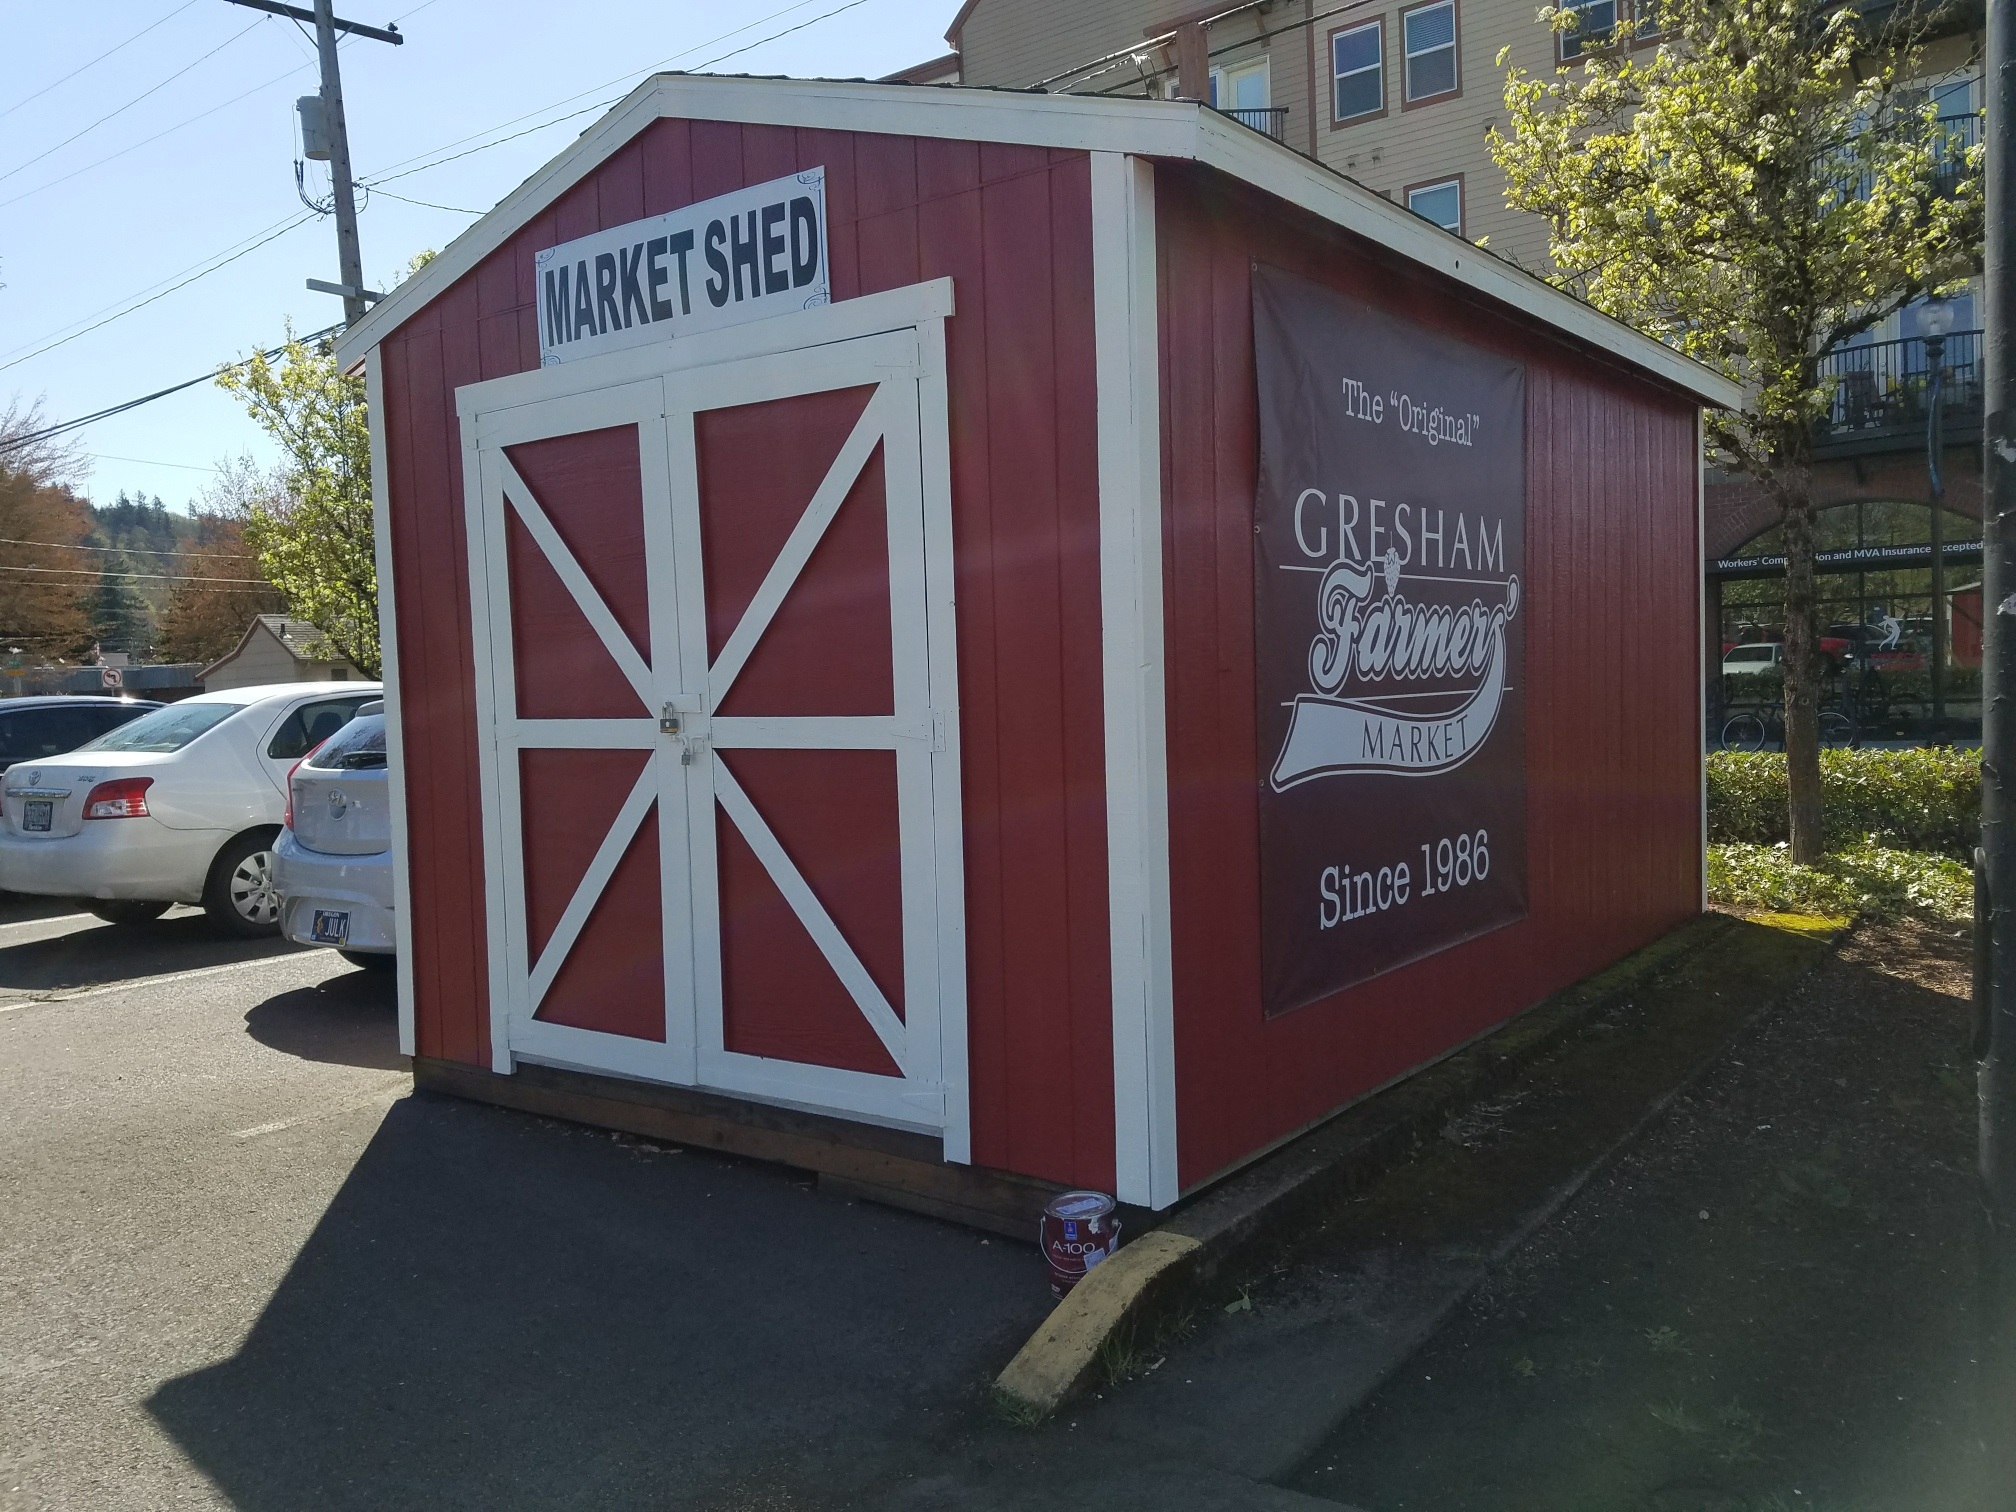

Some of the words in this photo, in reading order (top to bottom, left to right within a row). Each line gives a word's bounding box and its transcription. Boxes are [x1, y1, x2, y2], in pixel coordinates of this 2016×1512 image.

[545, 228, 694, 347] MARKET
[704, 195, 818, 308] SHED
[1342, 377, 1384, 424] The
[1294, 488, 1504, 573] GRESHAM
[1717, 557, 1760, 569] Workers'
[1833, 550, 1852, 561] and
[1854, 548, 1880, 558] MVA
[1882, 545, 1932, 557] Insurance
[1942, 541, 1984, 553] ccepted
[1361, 713, 1469, 763] MARKET
[1319, 861, 1411, 931] Since
[1420, 829, 1490, 898] 1986
[1052, 1240, 1096, 1255] A-100
